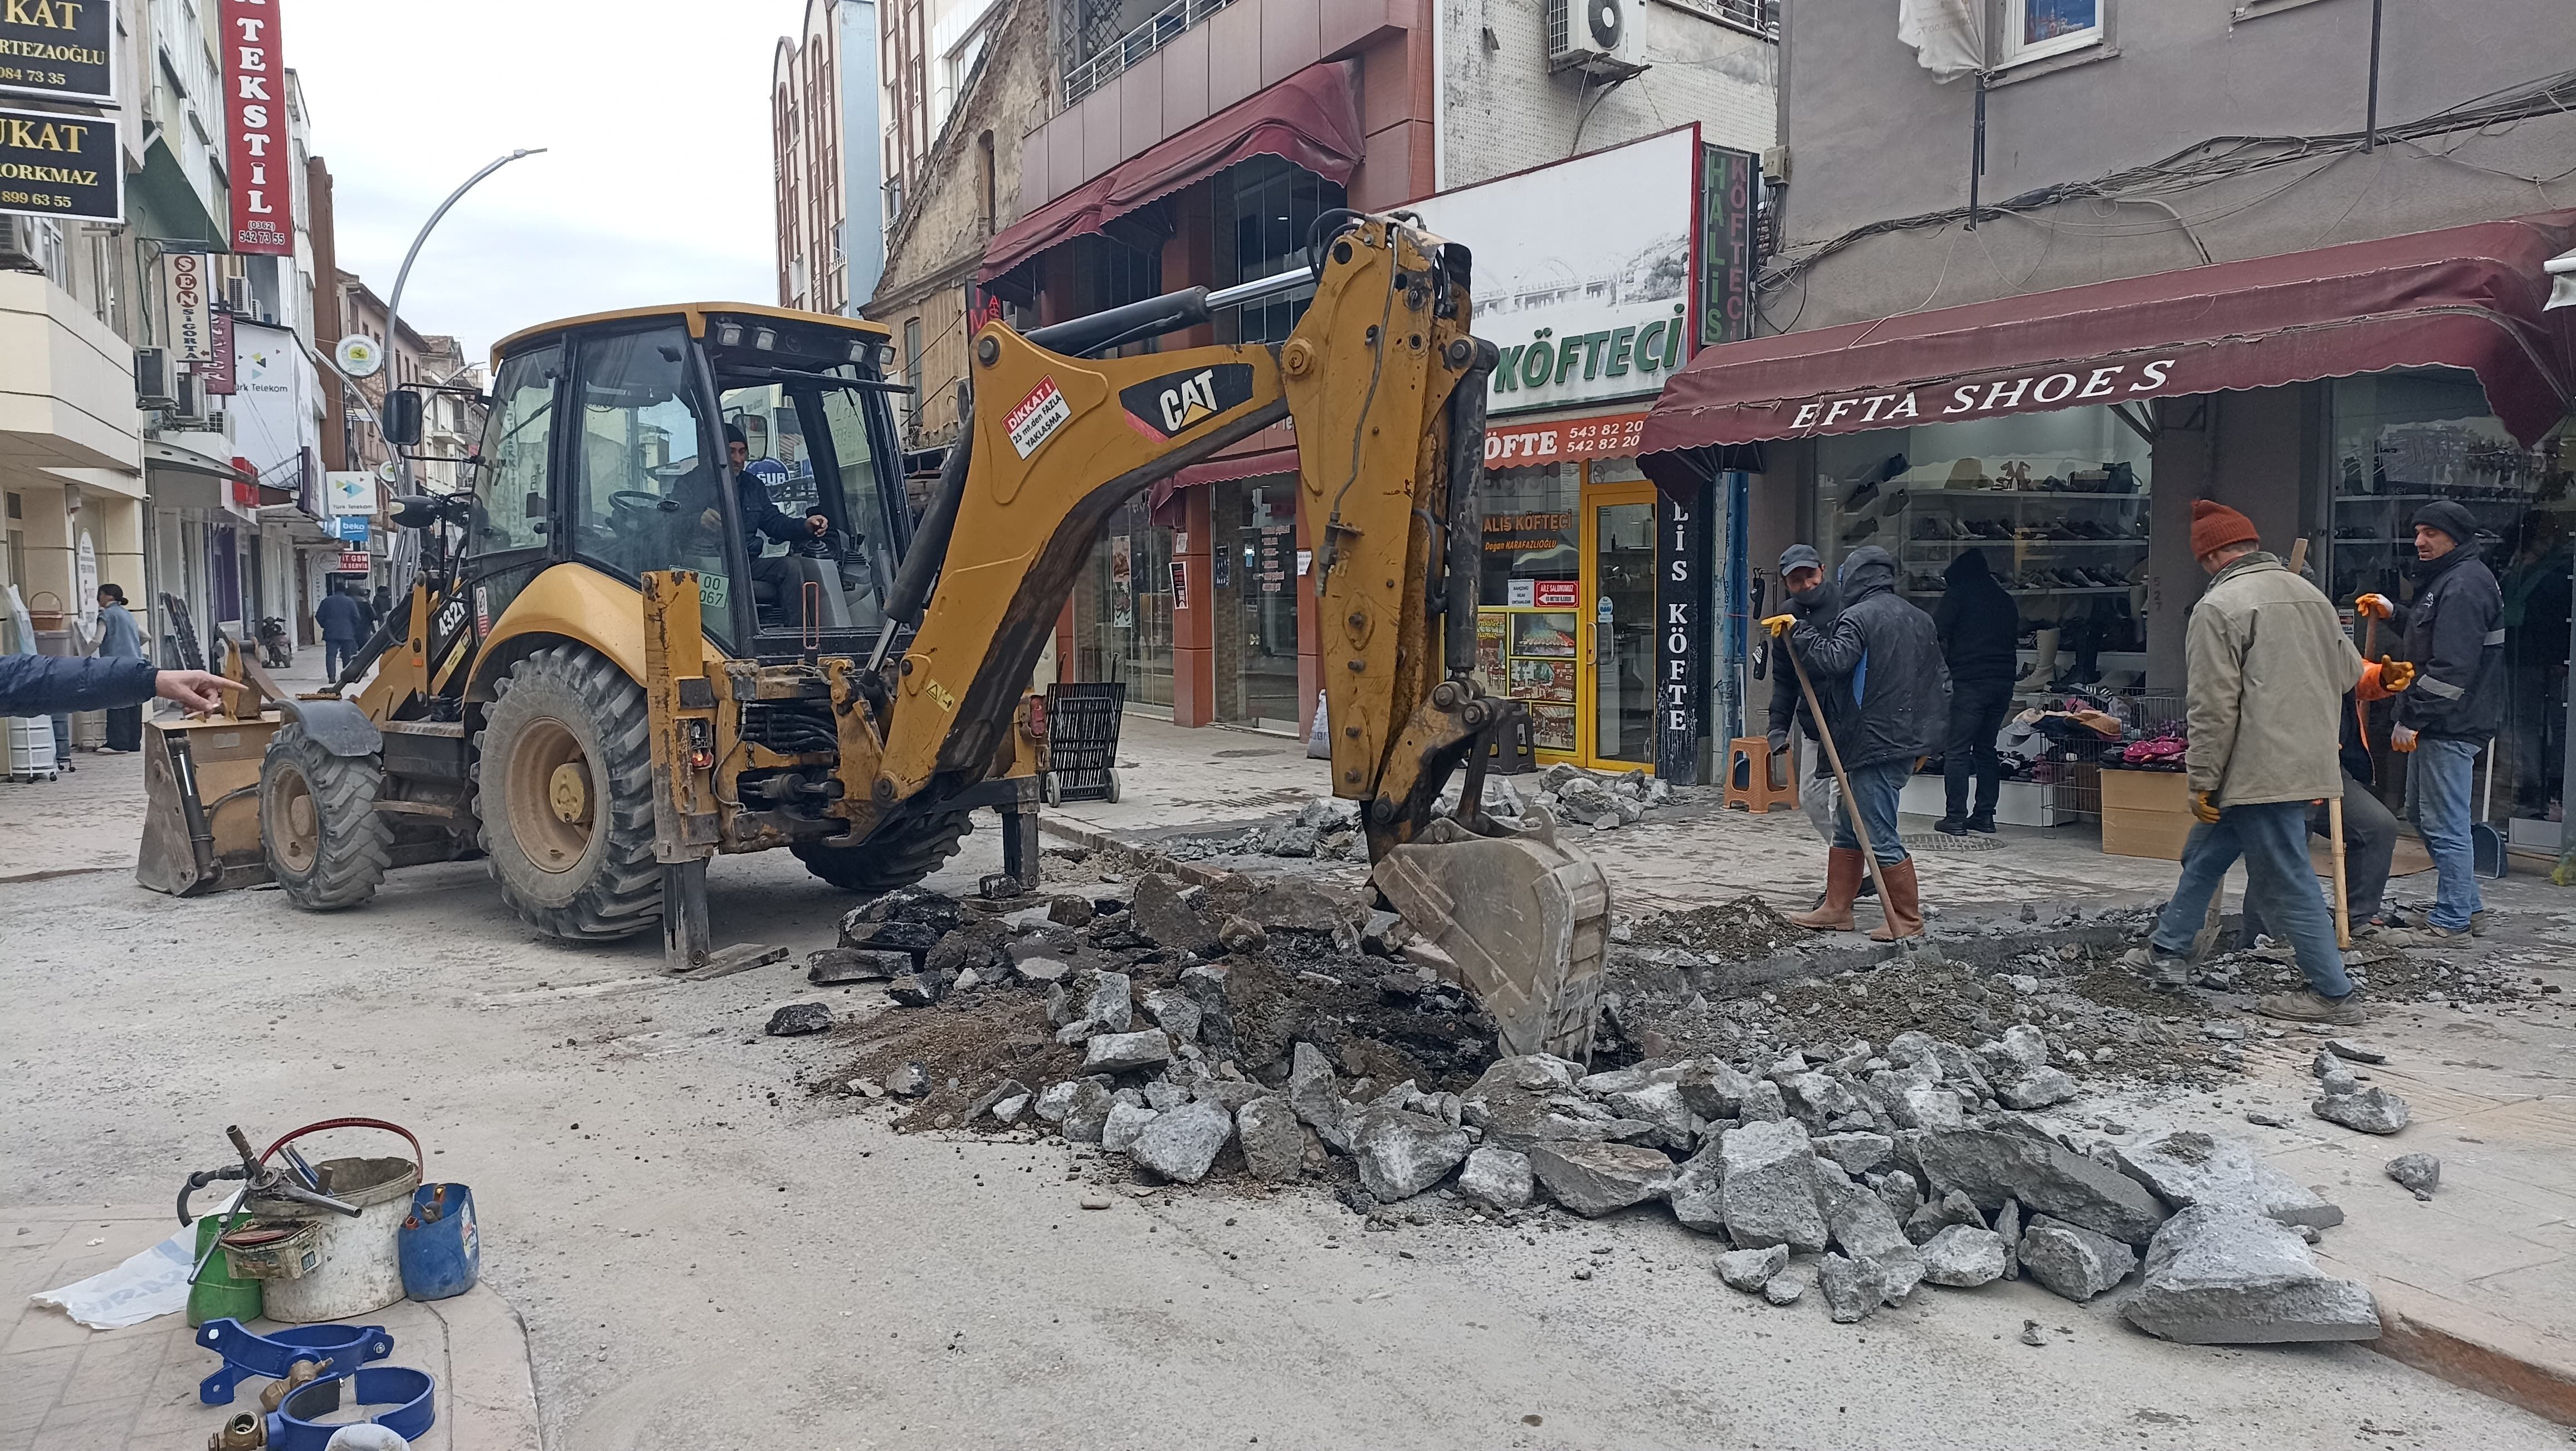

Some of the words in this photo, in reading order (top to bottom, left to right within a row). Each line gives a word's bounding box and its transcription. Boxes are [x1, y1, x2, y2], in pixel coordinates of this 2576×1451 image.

[0, 38, 105, 65] RTEZAOĞLU
[27, 70, 44, 82] 73
[48, 72, 66, 85] 35
[237, 17, 272, 214] TEKSTİL
[2, 191, 28, 204] 899
[32, 193, 50, 206] 63
[53, 195, 72, 208] 55
[238, 230, 257, 244] 542
[258, 232, 271, 243] 73
[272, 232, 285, 244] 55
[248, 221, 275, 231] (0362)
[1706, 155, 1726, 340] HALİS
[1727, 156, 1747, 342] KÖFTECİ
[176, 256, 198, 306] SEN
[1494, 303, 1684, 393] KÖFTECİ
[252, 383, 289, 393] Telekom
[1159, 368, 1218, 431] CAT
[1007, 388, 1045, 431] DİKKAT
[1012, 432, 1022, 445] 25
[1042, 395, 1062, 415] FAZLA
[1788, 391, 1919, 429] EFTA
[1025, 412, 1062, 448] YAKLAŞMA
[1566, 440, 1594, 452] 542
[1598, 437, 1618, 450] 82
[1622, 434, 1640, 447] 20
[1569, 425, 1597, 439] 543
[1601, 423, 1620, 436] 82
[1625, 420, 1644, 433] 20
[1540, 583, 1549, 592] AİLE
[1668, 603, 1688, 731] KÖFTE
